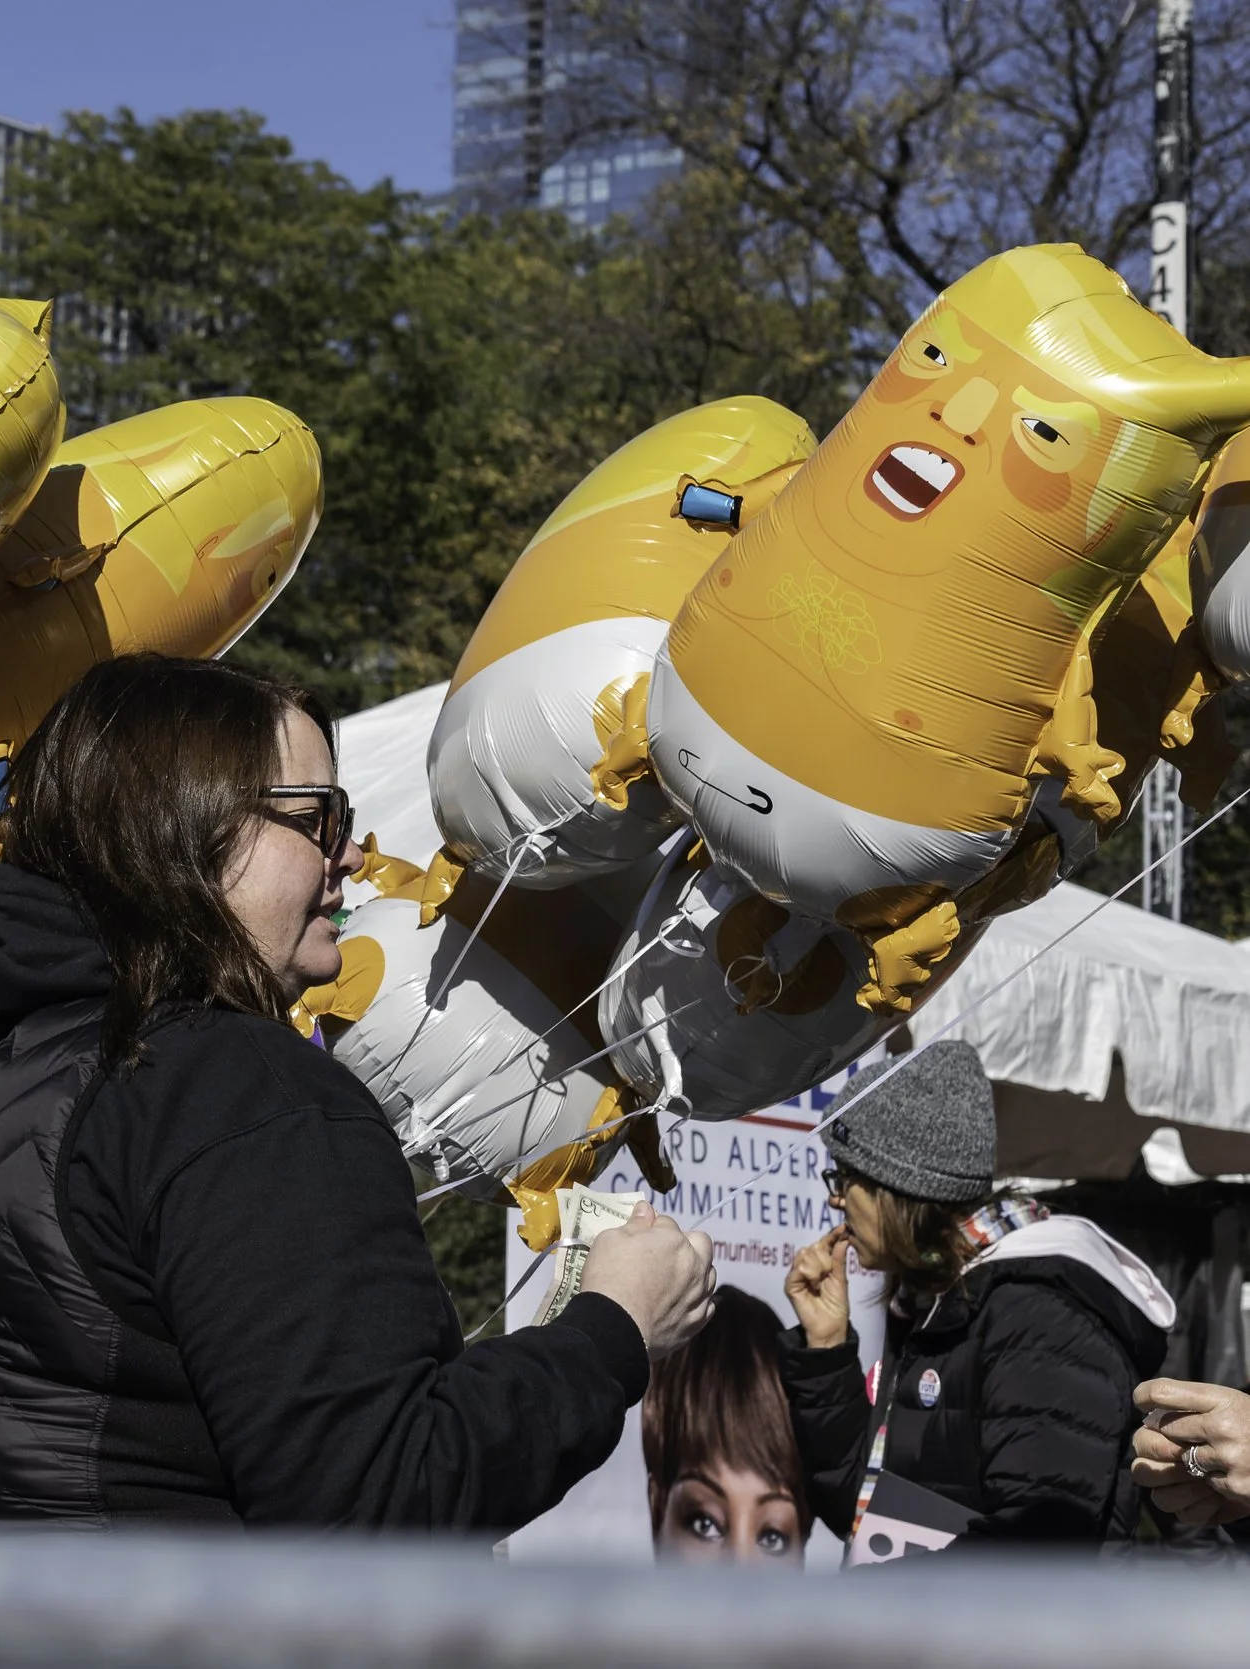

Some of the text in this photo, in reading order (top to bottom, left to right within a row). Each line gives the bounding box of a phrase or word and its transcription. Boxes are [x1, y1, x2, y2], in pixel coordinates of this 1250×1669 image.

[1150, 215, 1176, 326] C4
[728, 1136, 832, 1179] ALDER
[611, 1173, 843, 1231] CMMITTEEMA
